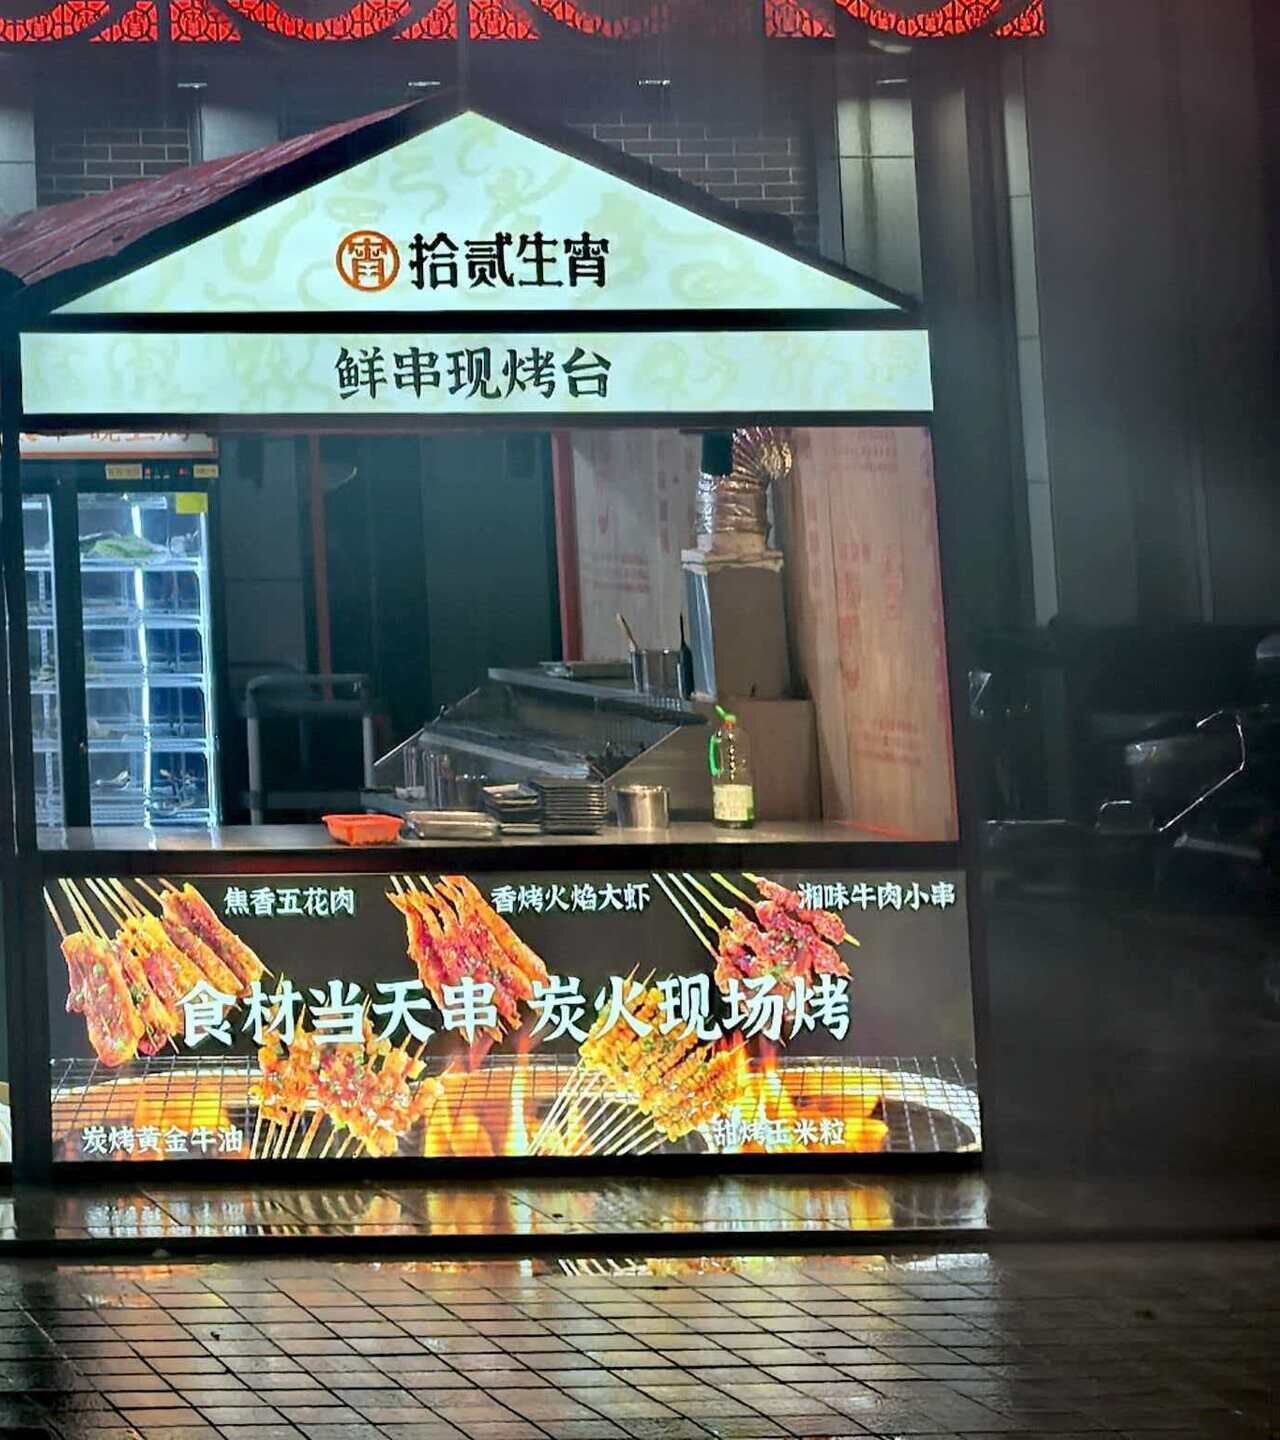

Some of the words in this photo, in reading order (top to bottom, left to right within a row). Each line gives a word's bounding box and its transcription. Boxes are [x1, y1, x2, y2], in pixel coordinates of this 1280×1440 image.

[409, 232, 609, 289] 拾贰生宵
[333, 346, 612, 400] 鲜串现烤台
[223, 886, 356, 915] 焦香五花肉
[491, 882, 651, 914] 香烤火焰大虾
[797, 883, 956, 912] 湘味牛肉小串
[176, 975, 501, 1048] 食材当天串
[528, 973, 854, 1042] 炭火现场烤
[81, 1125, 244, 1156] 炭烤黄金牛油
